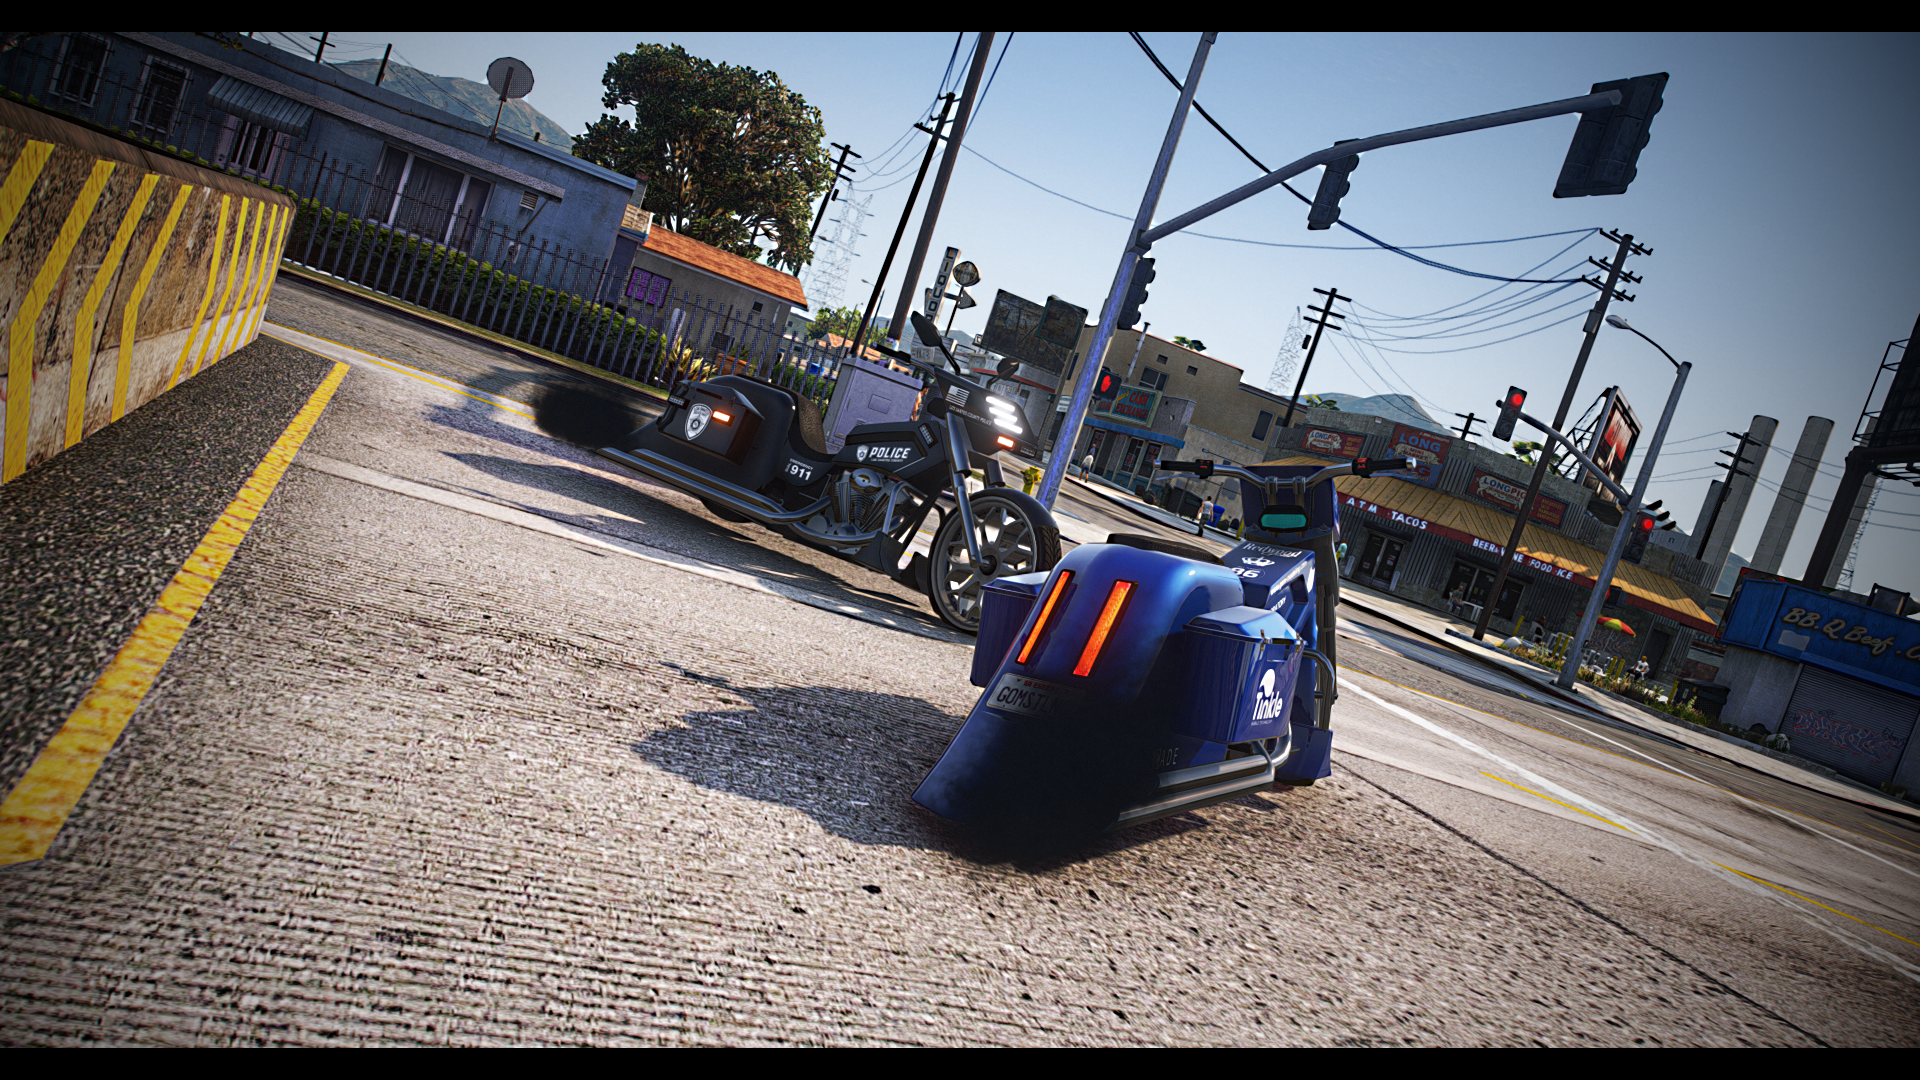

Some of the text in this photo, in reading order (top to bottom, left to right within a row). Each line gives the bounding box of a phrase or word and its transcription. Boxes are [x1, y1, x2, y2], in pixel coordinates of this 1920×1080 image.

[1115, 403, 1150, 420] EXCHANGE
[1400, 433, 1441, 452] LONG
[868, 447, 912, 460] POLICE
[790, 465, 812, 480] 911
[1391, 511, 1428, 530] TACOS
[1242, 543, 1302, 558] Redwood
[1530, 558, 1552, 573] FOOD
[1557, 569, 1574, 580] ICE
[1844, 626, 1895, 656] Beef
[1253, 690, 1283, 720] Tinkle
